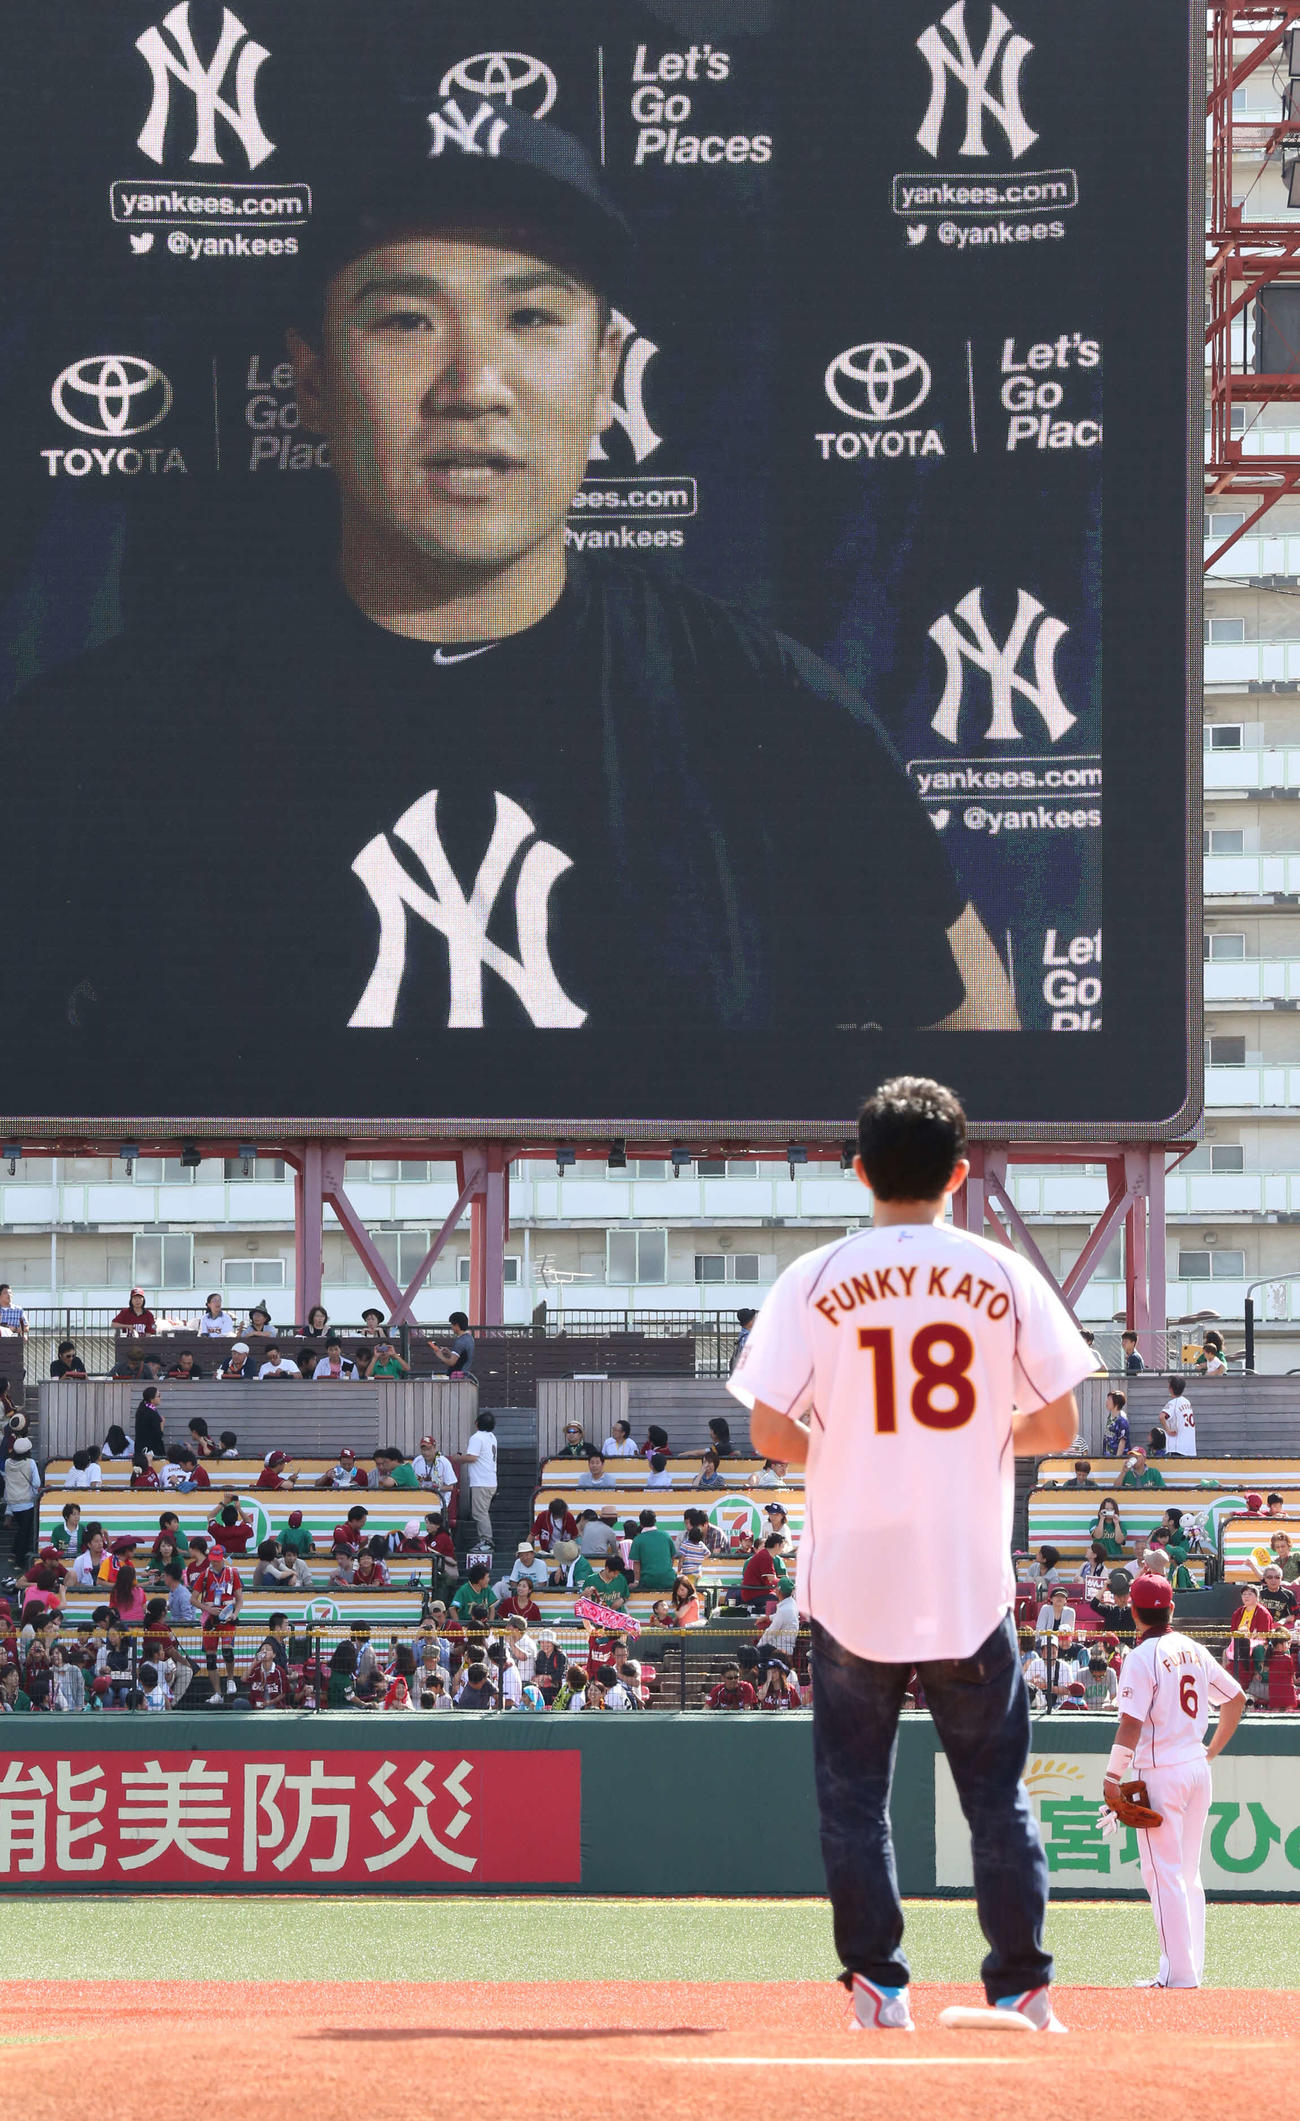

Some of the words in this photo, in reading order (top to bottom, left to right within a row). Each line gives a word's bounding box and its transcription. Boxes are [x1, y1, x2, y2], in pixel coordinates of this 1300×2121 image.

[632, 44, 730, 82] Let's
[631, 85, 691, 123] Go
[634, 127, 773, 165] Places
[121, 189, 303, 217] yankees.com
[902, 180, 1068, 207] yankees.com
[166, 231, 299, 260] @yankees
[937, 220, 1065, 249] @yankees
[1001, 332, 1101, 373] Let's
[1001, 375, 1063, 412] Go
[245, 394, 300, 431] Go
[814, 429, 945, 460] TOYOTA
[1006, 413, 1103, 451] Plac
[40, 447, 188, 477] TOYOTA
[249, 435, 332, 471] Plac
[572, 489, 689, 508] ees.com
[565, 525, 685, 551] yankees
[917, 768, 1102, 794] yankees.com
[963, 805, 1102, 835] @yankees
[1042, 968, 1102, 1008] Go
[815, 1266, 918, 1327] FUNKY
[928, 1266, 1011, 1321] KATO
[857, 1321, 977, 1435] 18
[1179, 1674, 1199, 1719] 6
[0, 1759, 479, 1873] 能美防災
